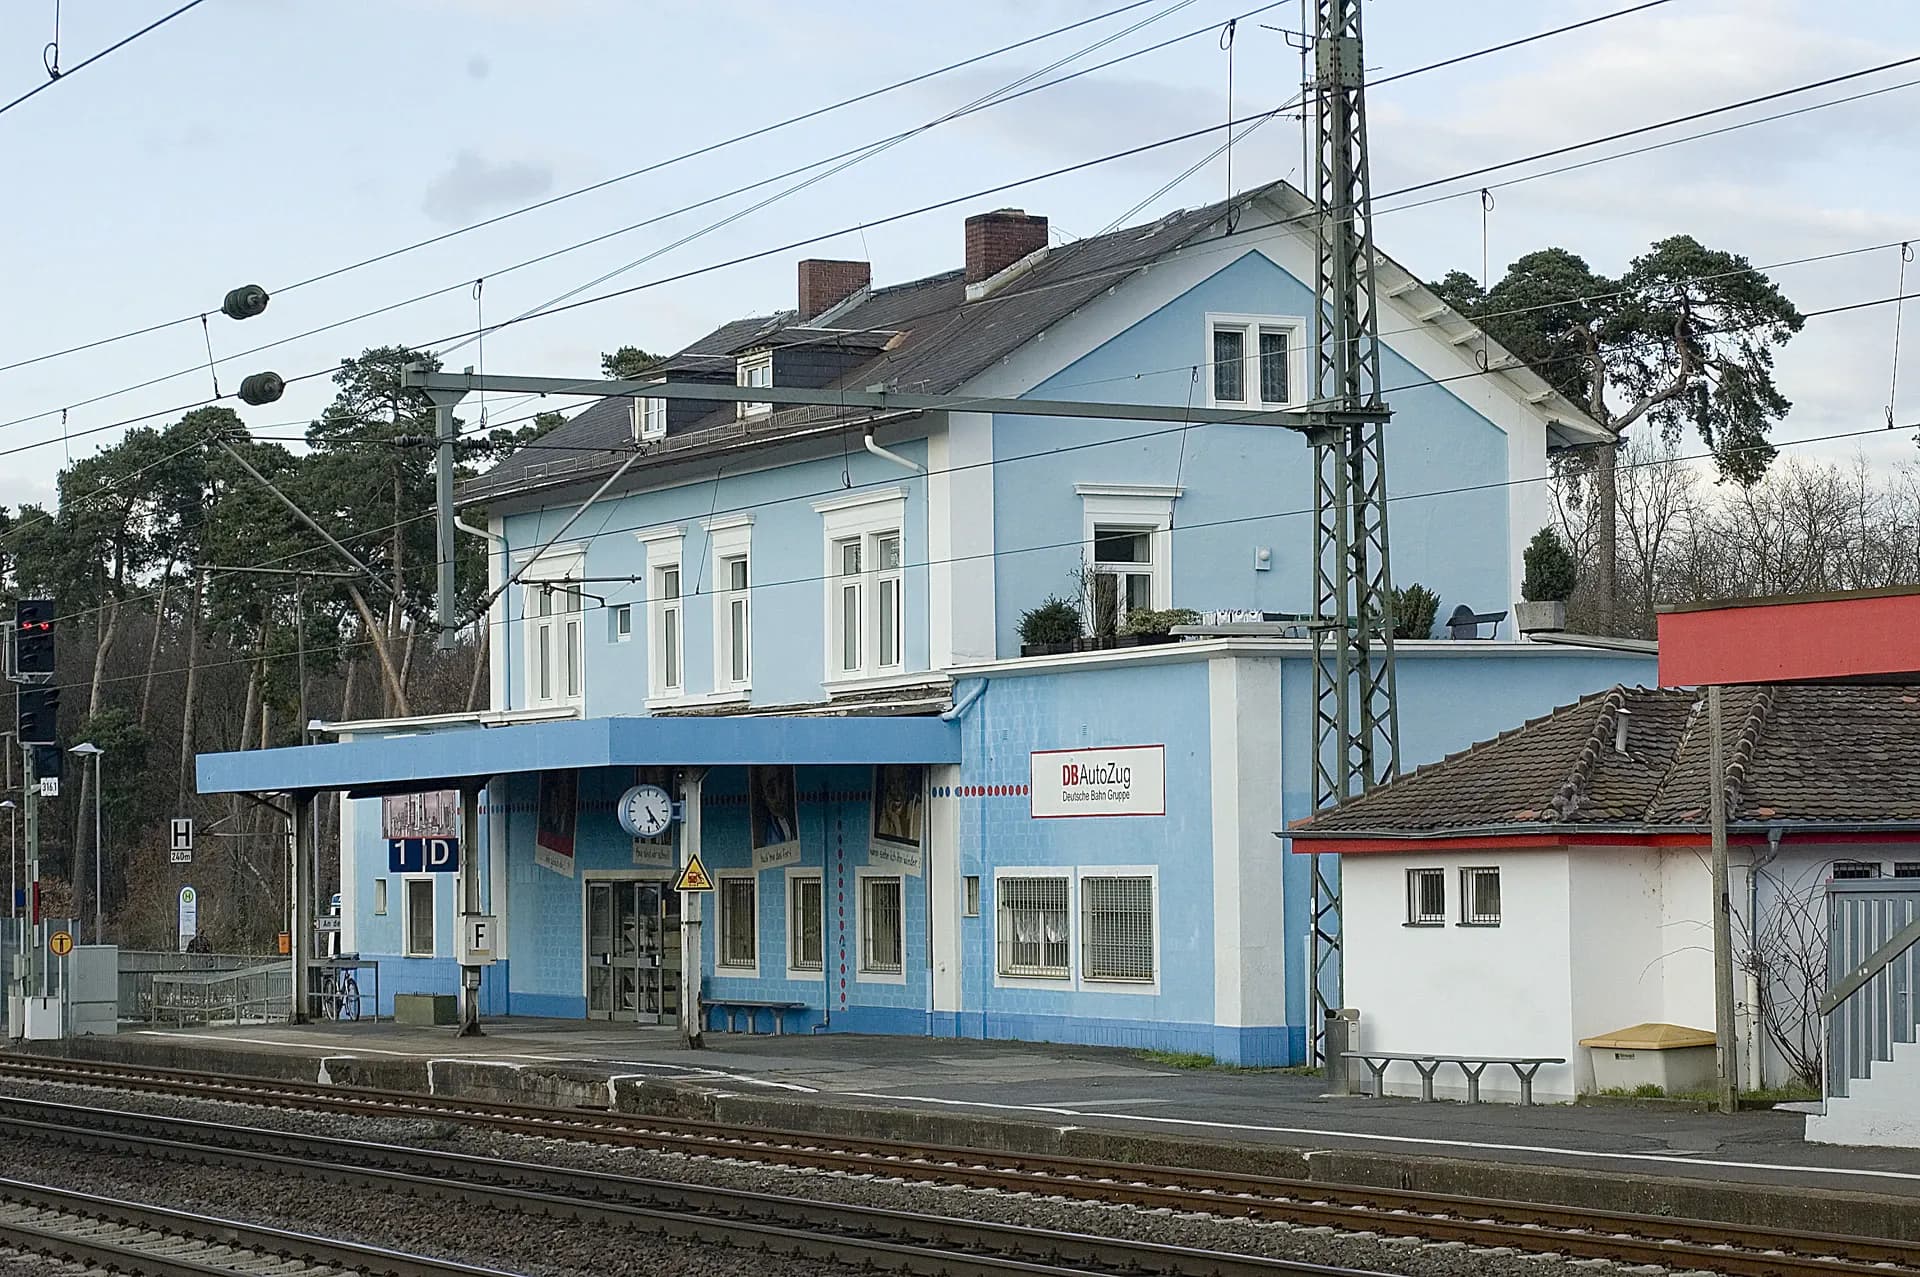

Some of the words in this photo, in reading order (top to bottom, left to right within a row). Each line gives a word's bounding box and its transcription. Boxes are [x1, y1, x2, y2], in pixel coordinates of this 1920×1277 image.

[1062, 791, 1090, 802] Deutsche
[1090, 789, 1107, 801] Bahn
[1107, 788, 1130, 803] Gruppe
[173, 821, 190, 847] H
[171, 852, 191, 861] 240m
[394, 839, 405, 865] 1
[430, 839, 450, 865] D
[475, 924, 485, 948] F
